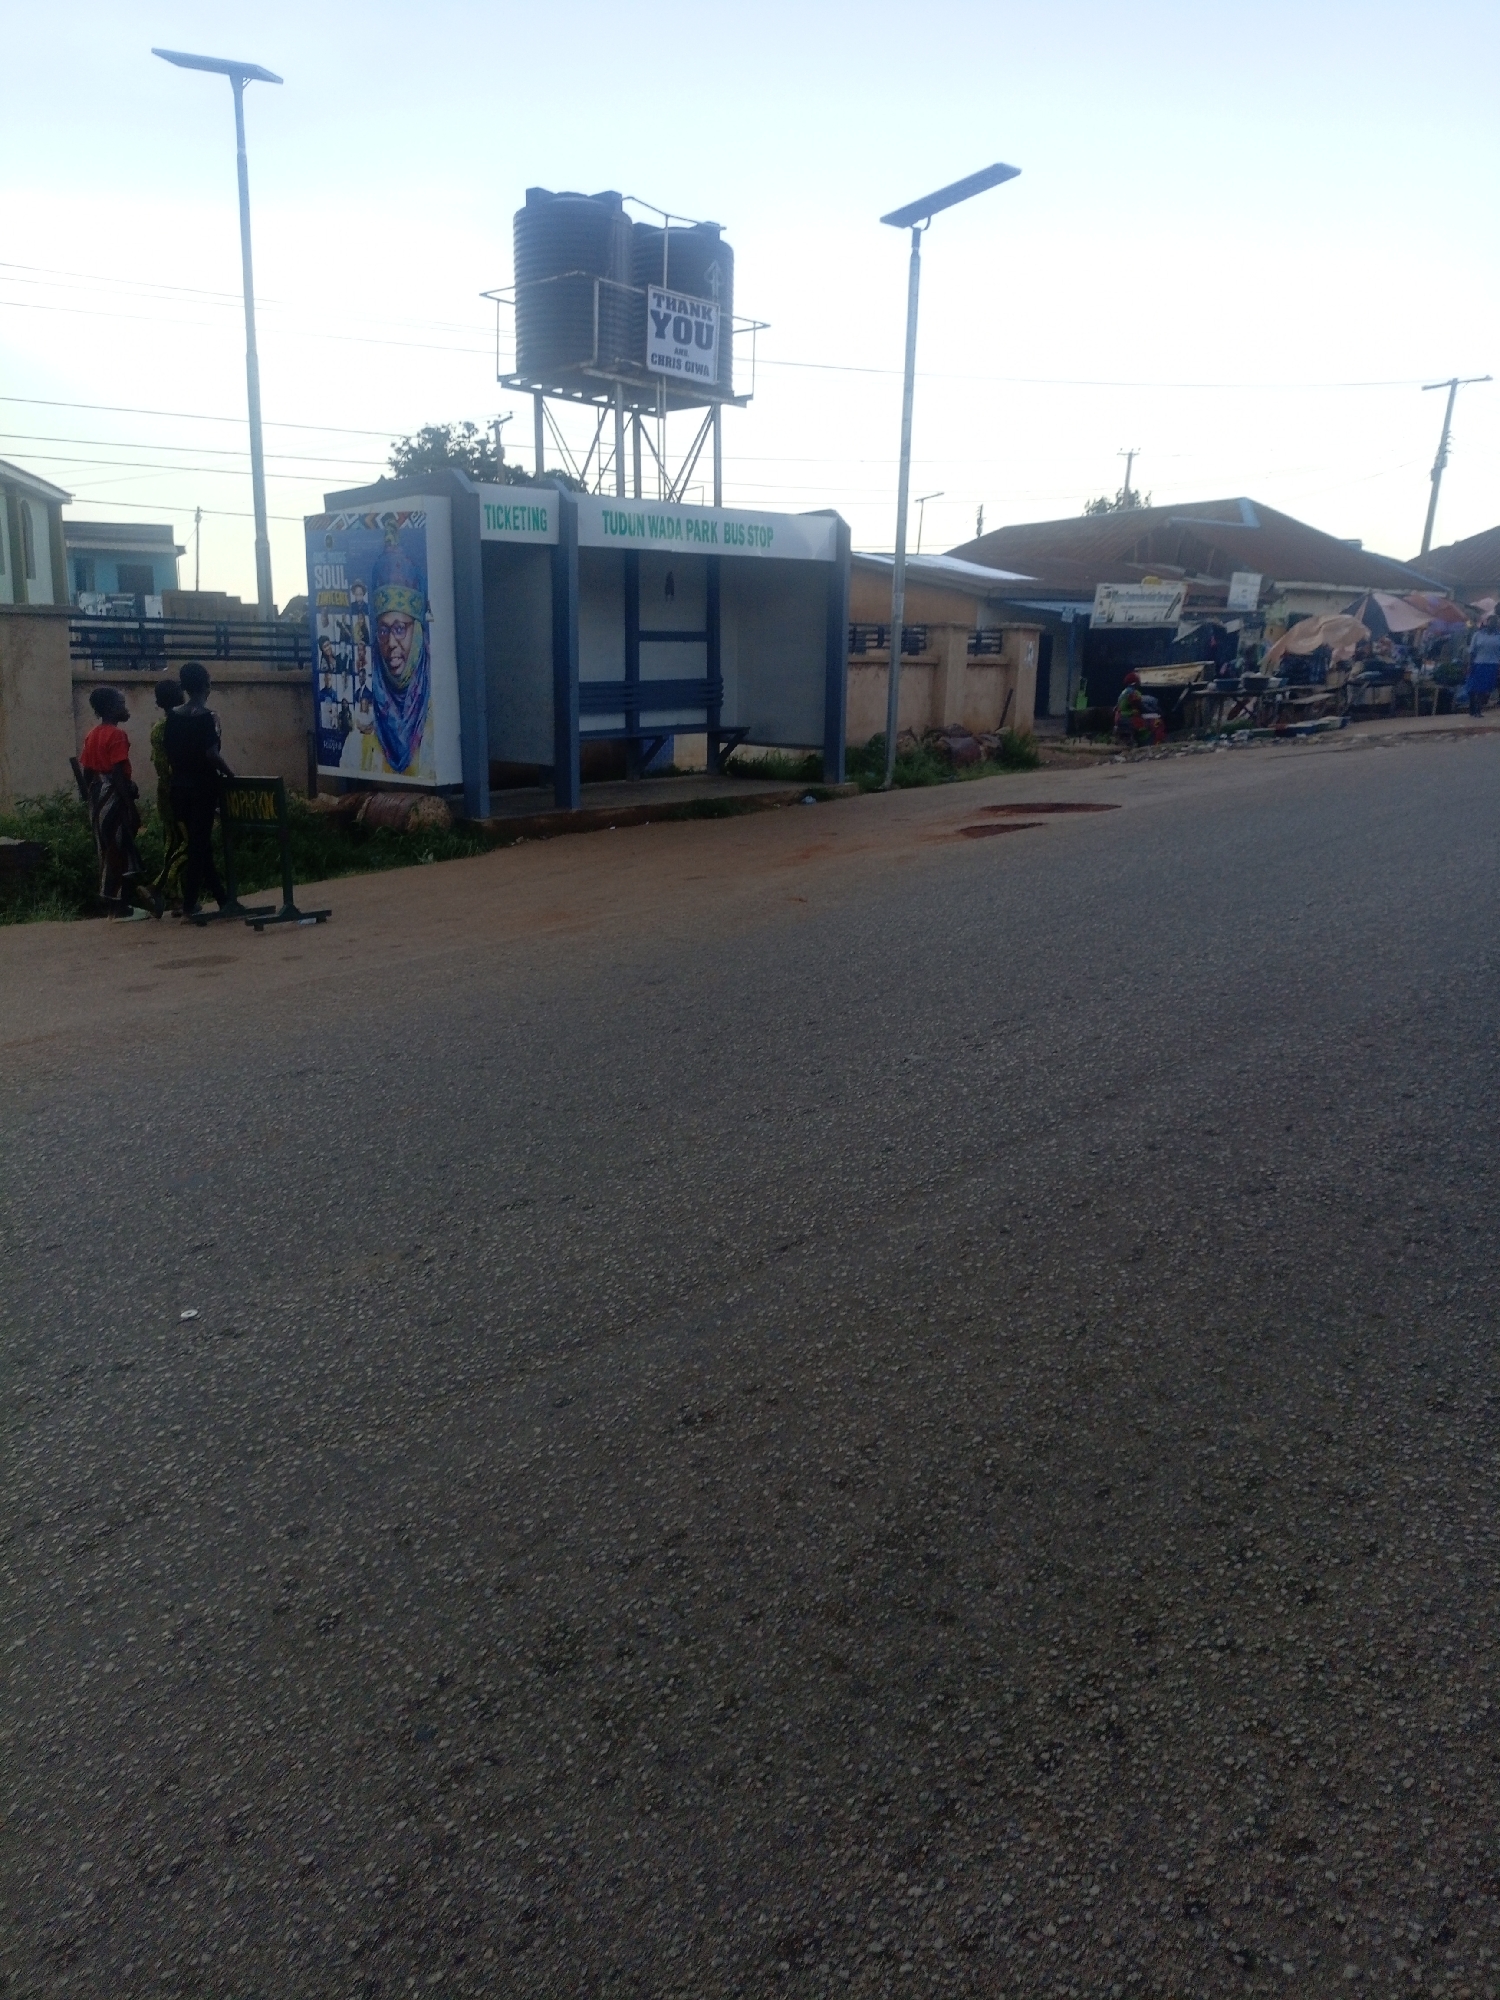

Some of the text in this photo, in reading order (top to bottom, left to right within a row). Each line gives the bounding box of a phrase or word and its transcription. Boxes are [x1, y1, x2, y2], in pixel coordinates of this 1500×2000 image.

[652, 292, 713, 322] THANK
[650, 309, 715, 350] YOU
[651, 352, 710, 377] CHRIS GIWA
[483, 504, 548, 532] TICKETING
[602, 510, 774, 548] TUDUN WADA PARK BUS STOP
[314, 565, 348, 590] SOUL
